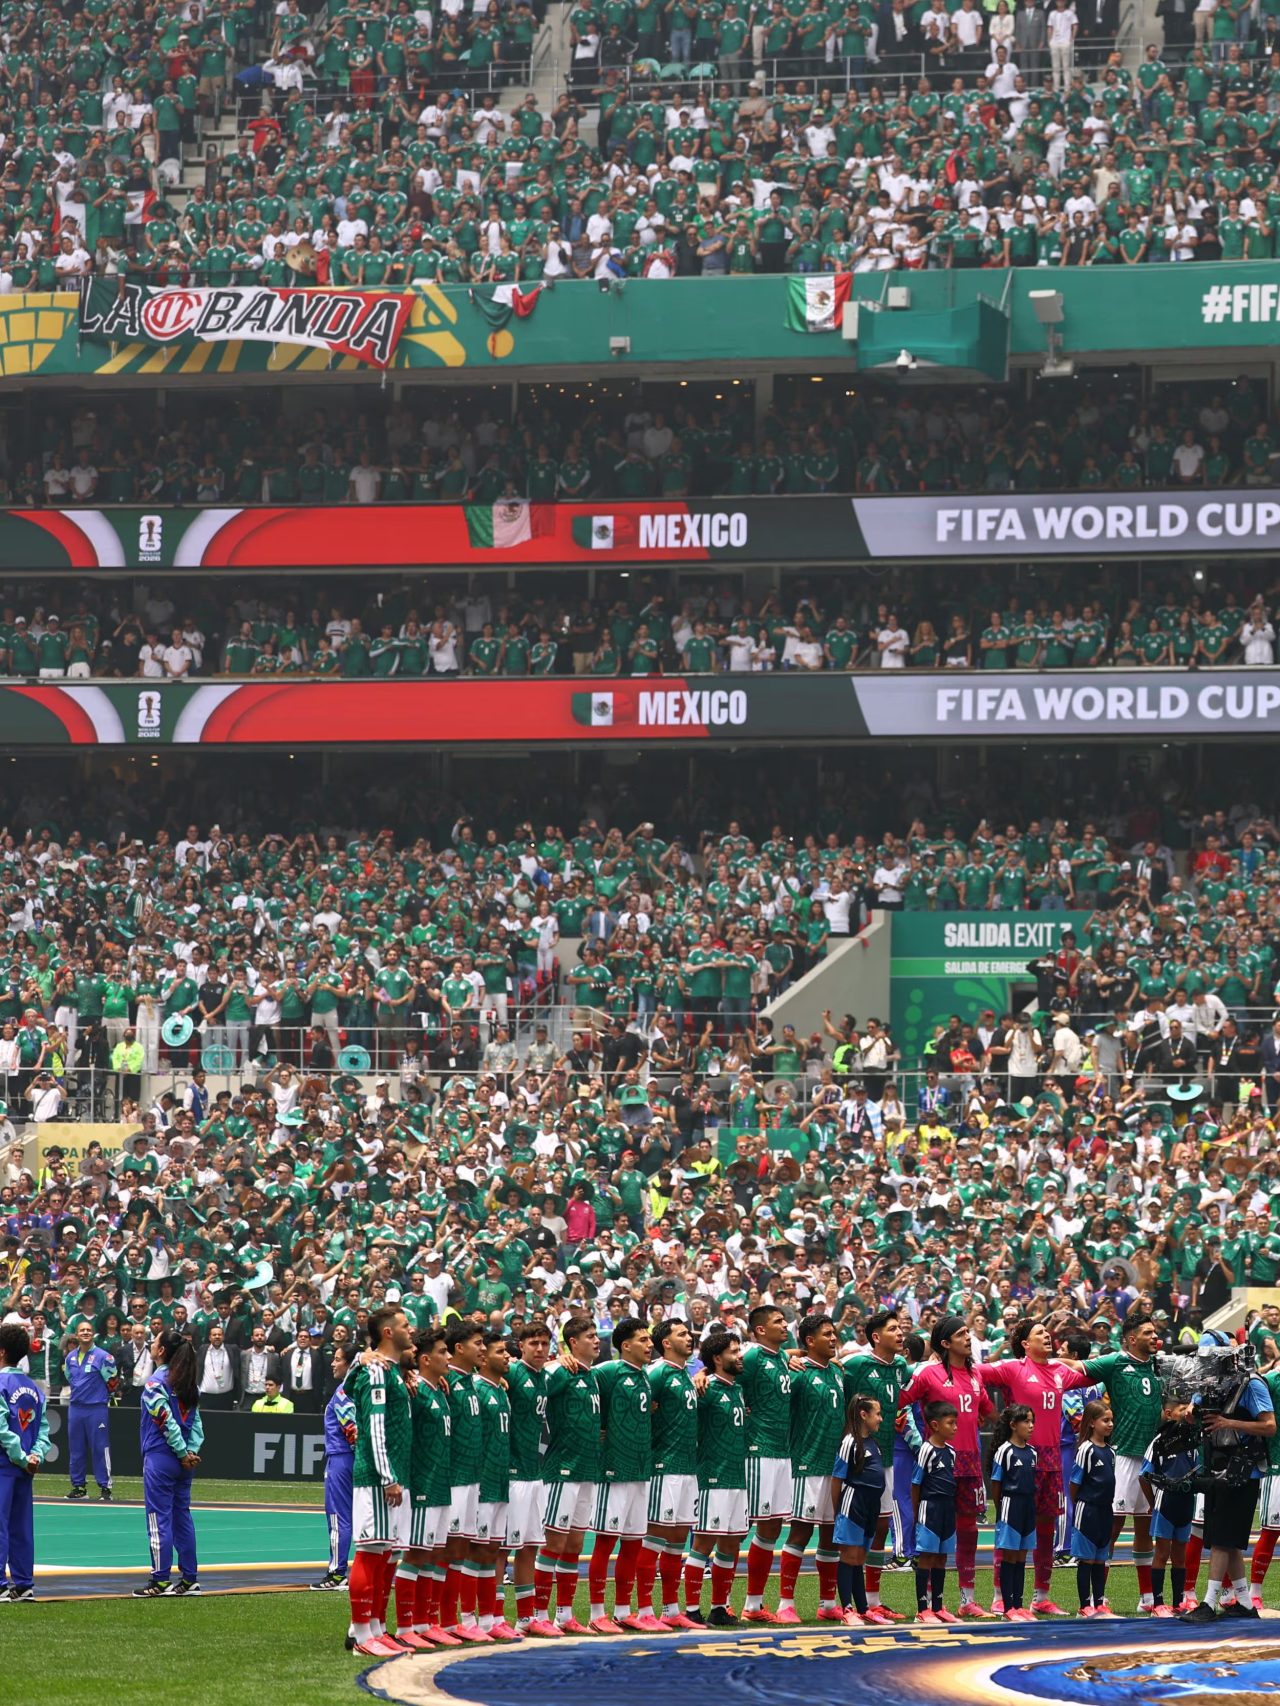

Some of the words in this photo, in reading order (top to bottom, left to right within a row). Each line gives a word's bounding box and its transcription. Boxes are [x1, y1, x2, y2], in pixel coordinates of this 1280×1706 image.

[78, 274, 143, 336] LA
[195, 291, 401, 364] BANDA
[639, 512, 748, 548] MEXICO
[935, 507, 1027, 542] FIFA
[1032, 504, 1189, 540] WORLD
[638, 690, 748, 725] MEXICO
[935, 687, 1027, 721] FIFA
[1032, 686, 1189, 721] WORLD
[944, 922, 1011, 947] SALIDA
[1014, 923, 1055, 947] EXIT
[944, 961, 977, 974] SALIDA
[978, 961, 989, 974] DE
[991, 961, 1029, 974] EMERGE
[779, 1374, 791, 1394] 22
[885, 1384, 894, 1403] 4
[1141, 1377, 1150, 1396] 9
[467, 1395, 479, 1417] 18
[639, 1392, 647, 1412] 2
[829, 1389, 838, 1409] 7
[958, 1394, 972, 1413] 12
[1042, 1391, 1056, 1410] 13
[499, 1412, 509, 1433] 17
[733, 1406, 744, 1426] 21
[253, 1432, 326, 1475] FIF
